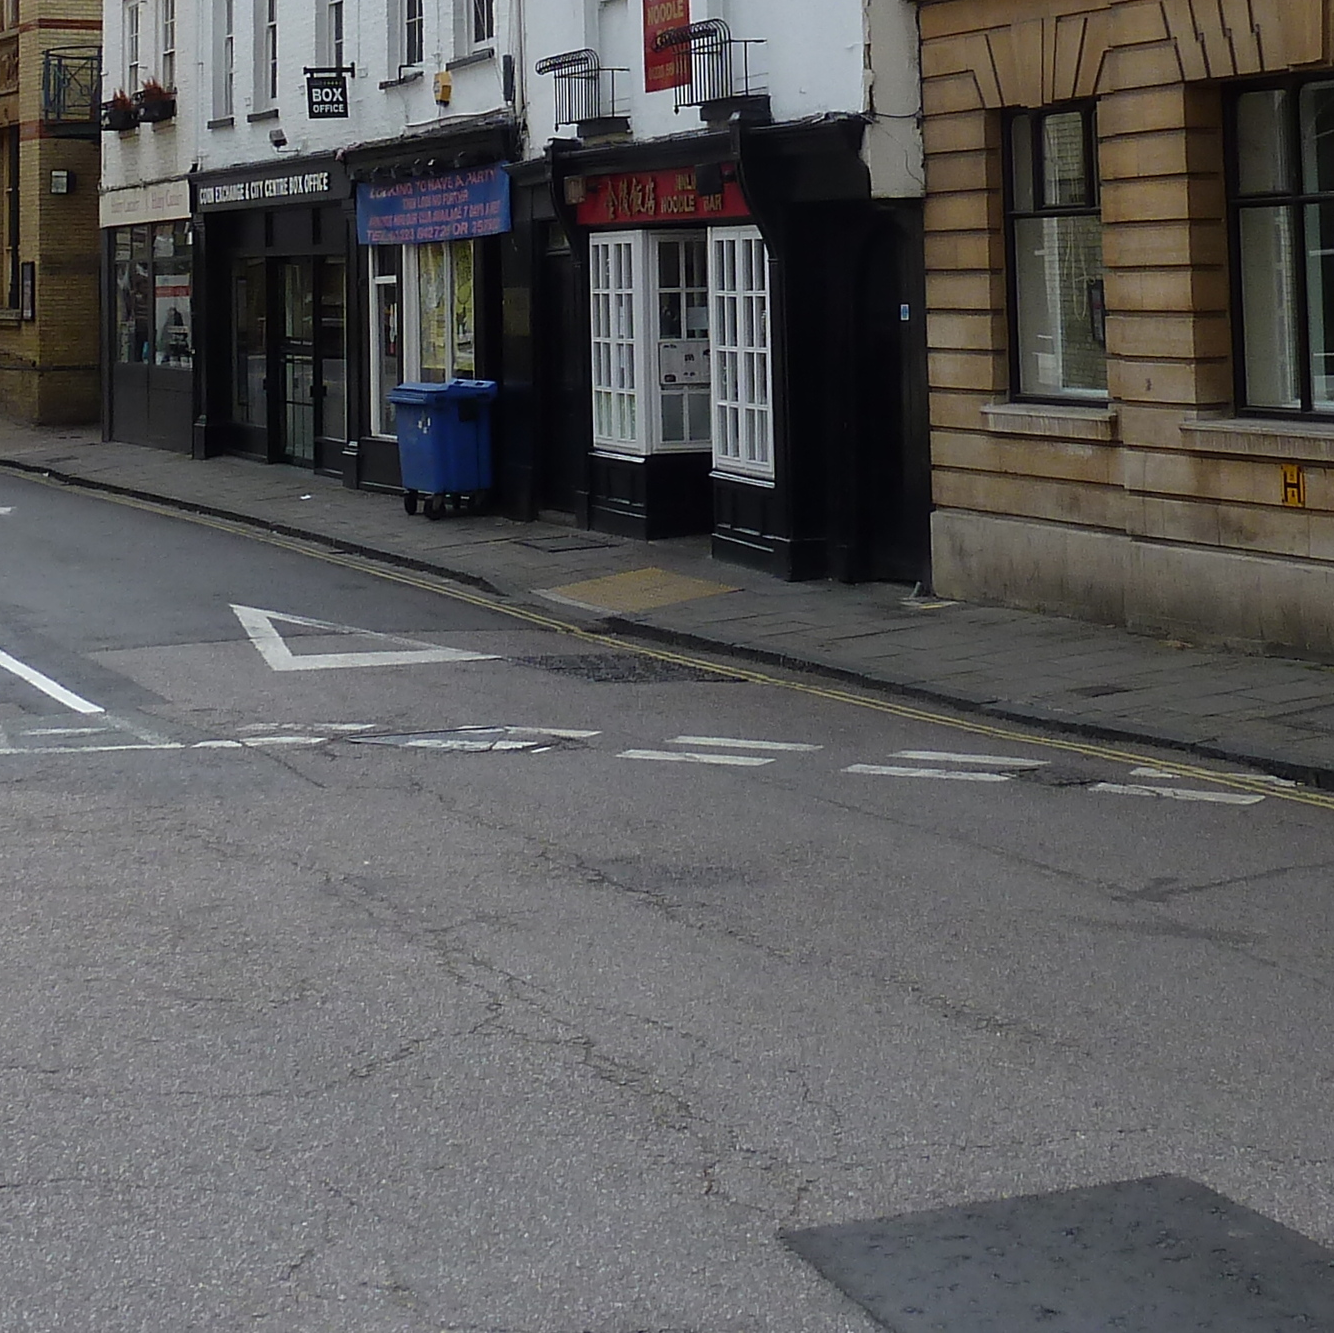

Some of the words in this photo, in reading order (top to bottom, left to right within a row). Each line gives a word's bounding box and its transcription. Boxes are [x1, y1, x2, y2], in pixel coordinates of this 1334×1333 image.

[312, 88, 344, 102] BOX
[312, 104, 345, 113] OFFICE
[304, 172, 329, 193] OFFICE
[661, 194, 695, 214] NOODLE
[703, 194, 723, 212] BAR
[452, 221, 468, 235] OR
[1283, 469, 1301, 503] H
